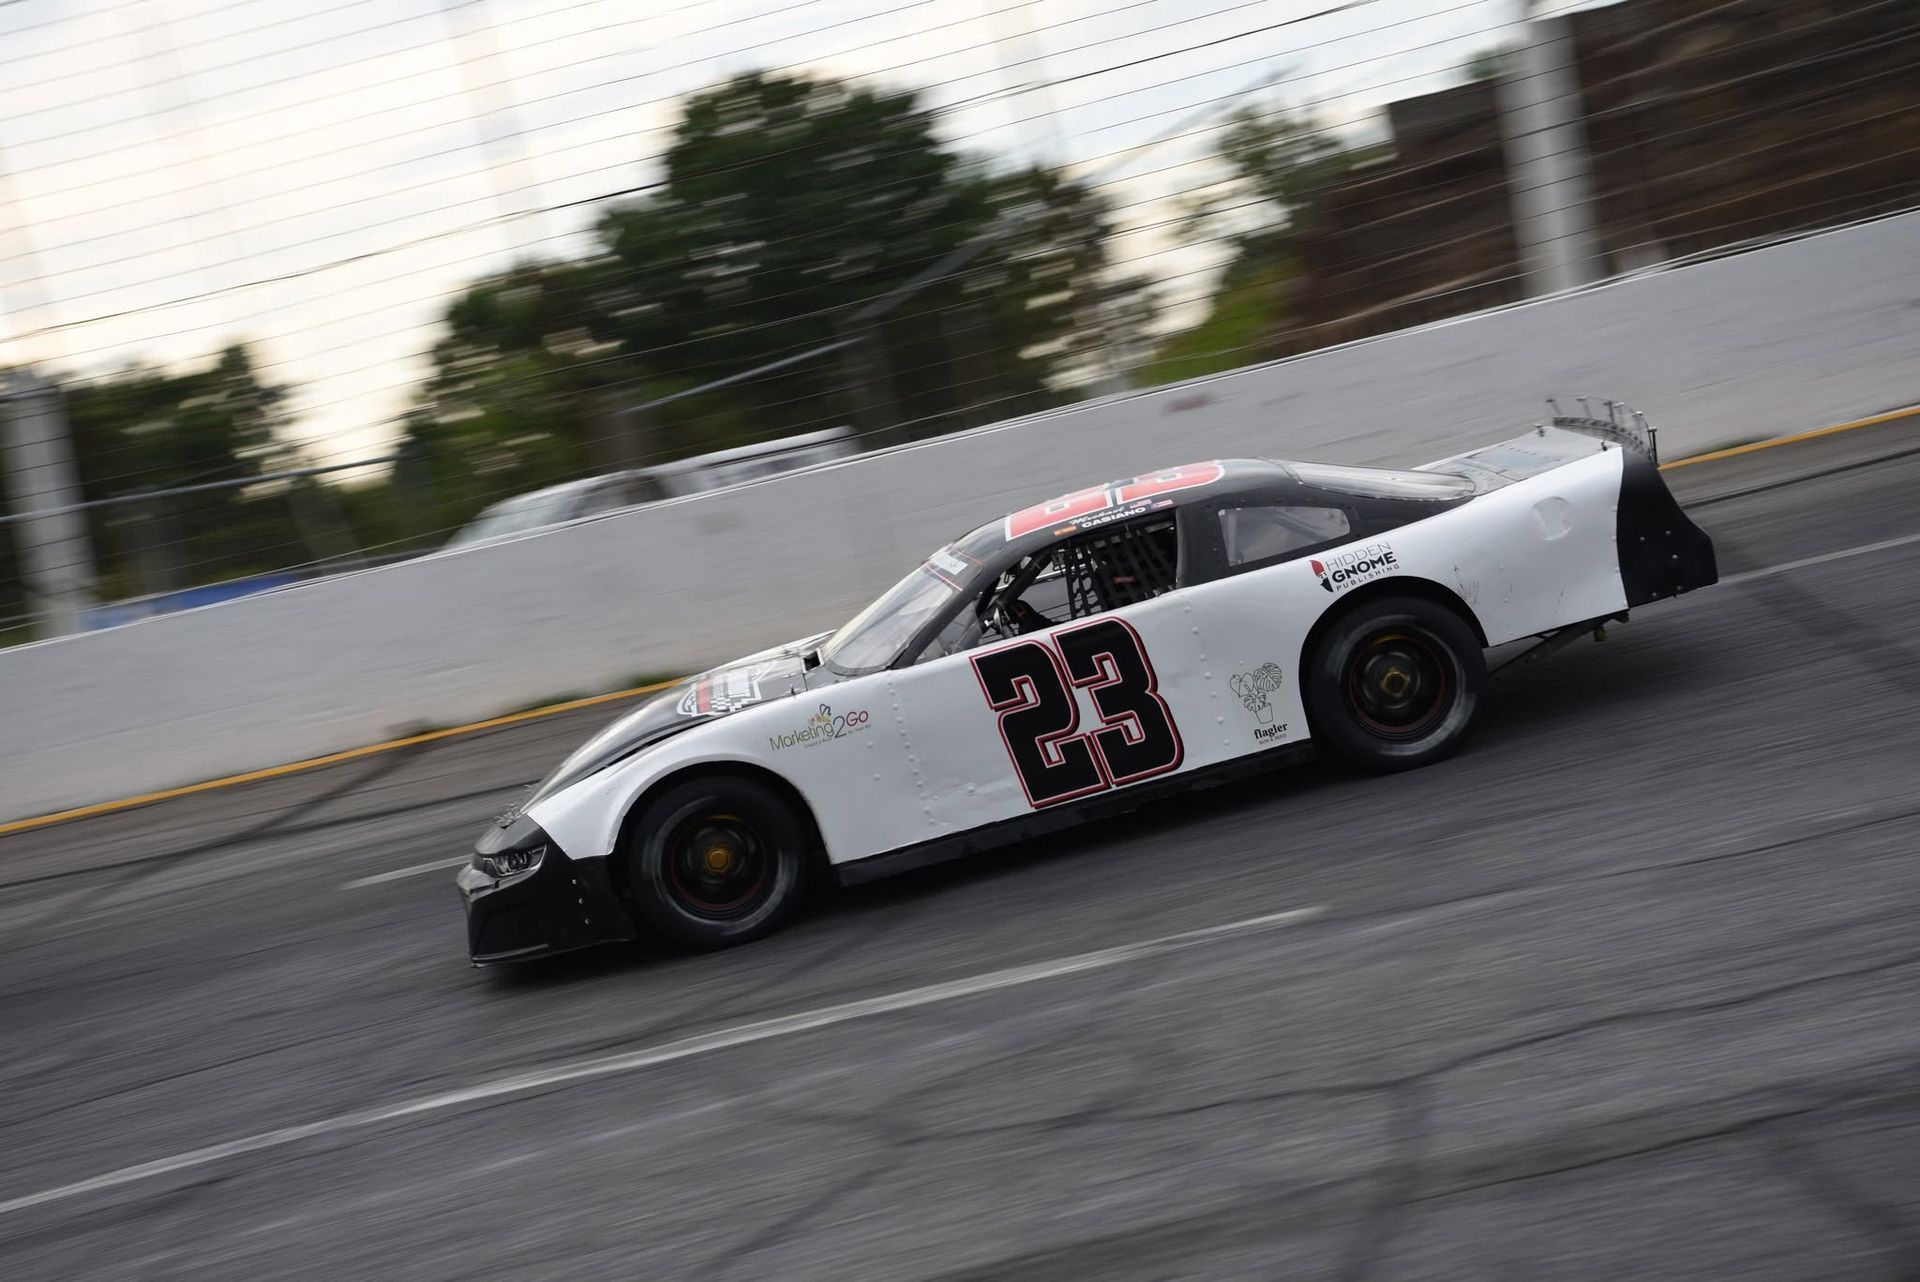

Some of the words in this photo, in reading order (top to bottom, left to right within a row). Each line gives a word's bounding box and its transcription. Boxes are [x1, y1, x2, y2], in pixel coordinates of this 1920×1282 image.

[1082, 507, 1146, 528] CASIANO
[1325, 541, 1392, 571] HIDDEN
[1332, 551, 1397, 583] GNOME
[1336, 564, 1400, 591] PUBLISHING
[969, 616, 1185, 809] 23
[769, 710, 869, 751] Marketing2Go
[1254, 723, 1288, 740] flagler
